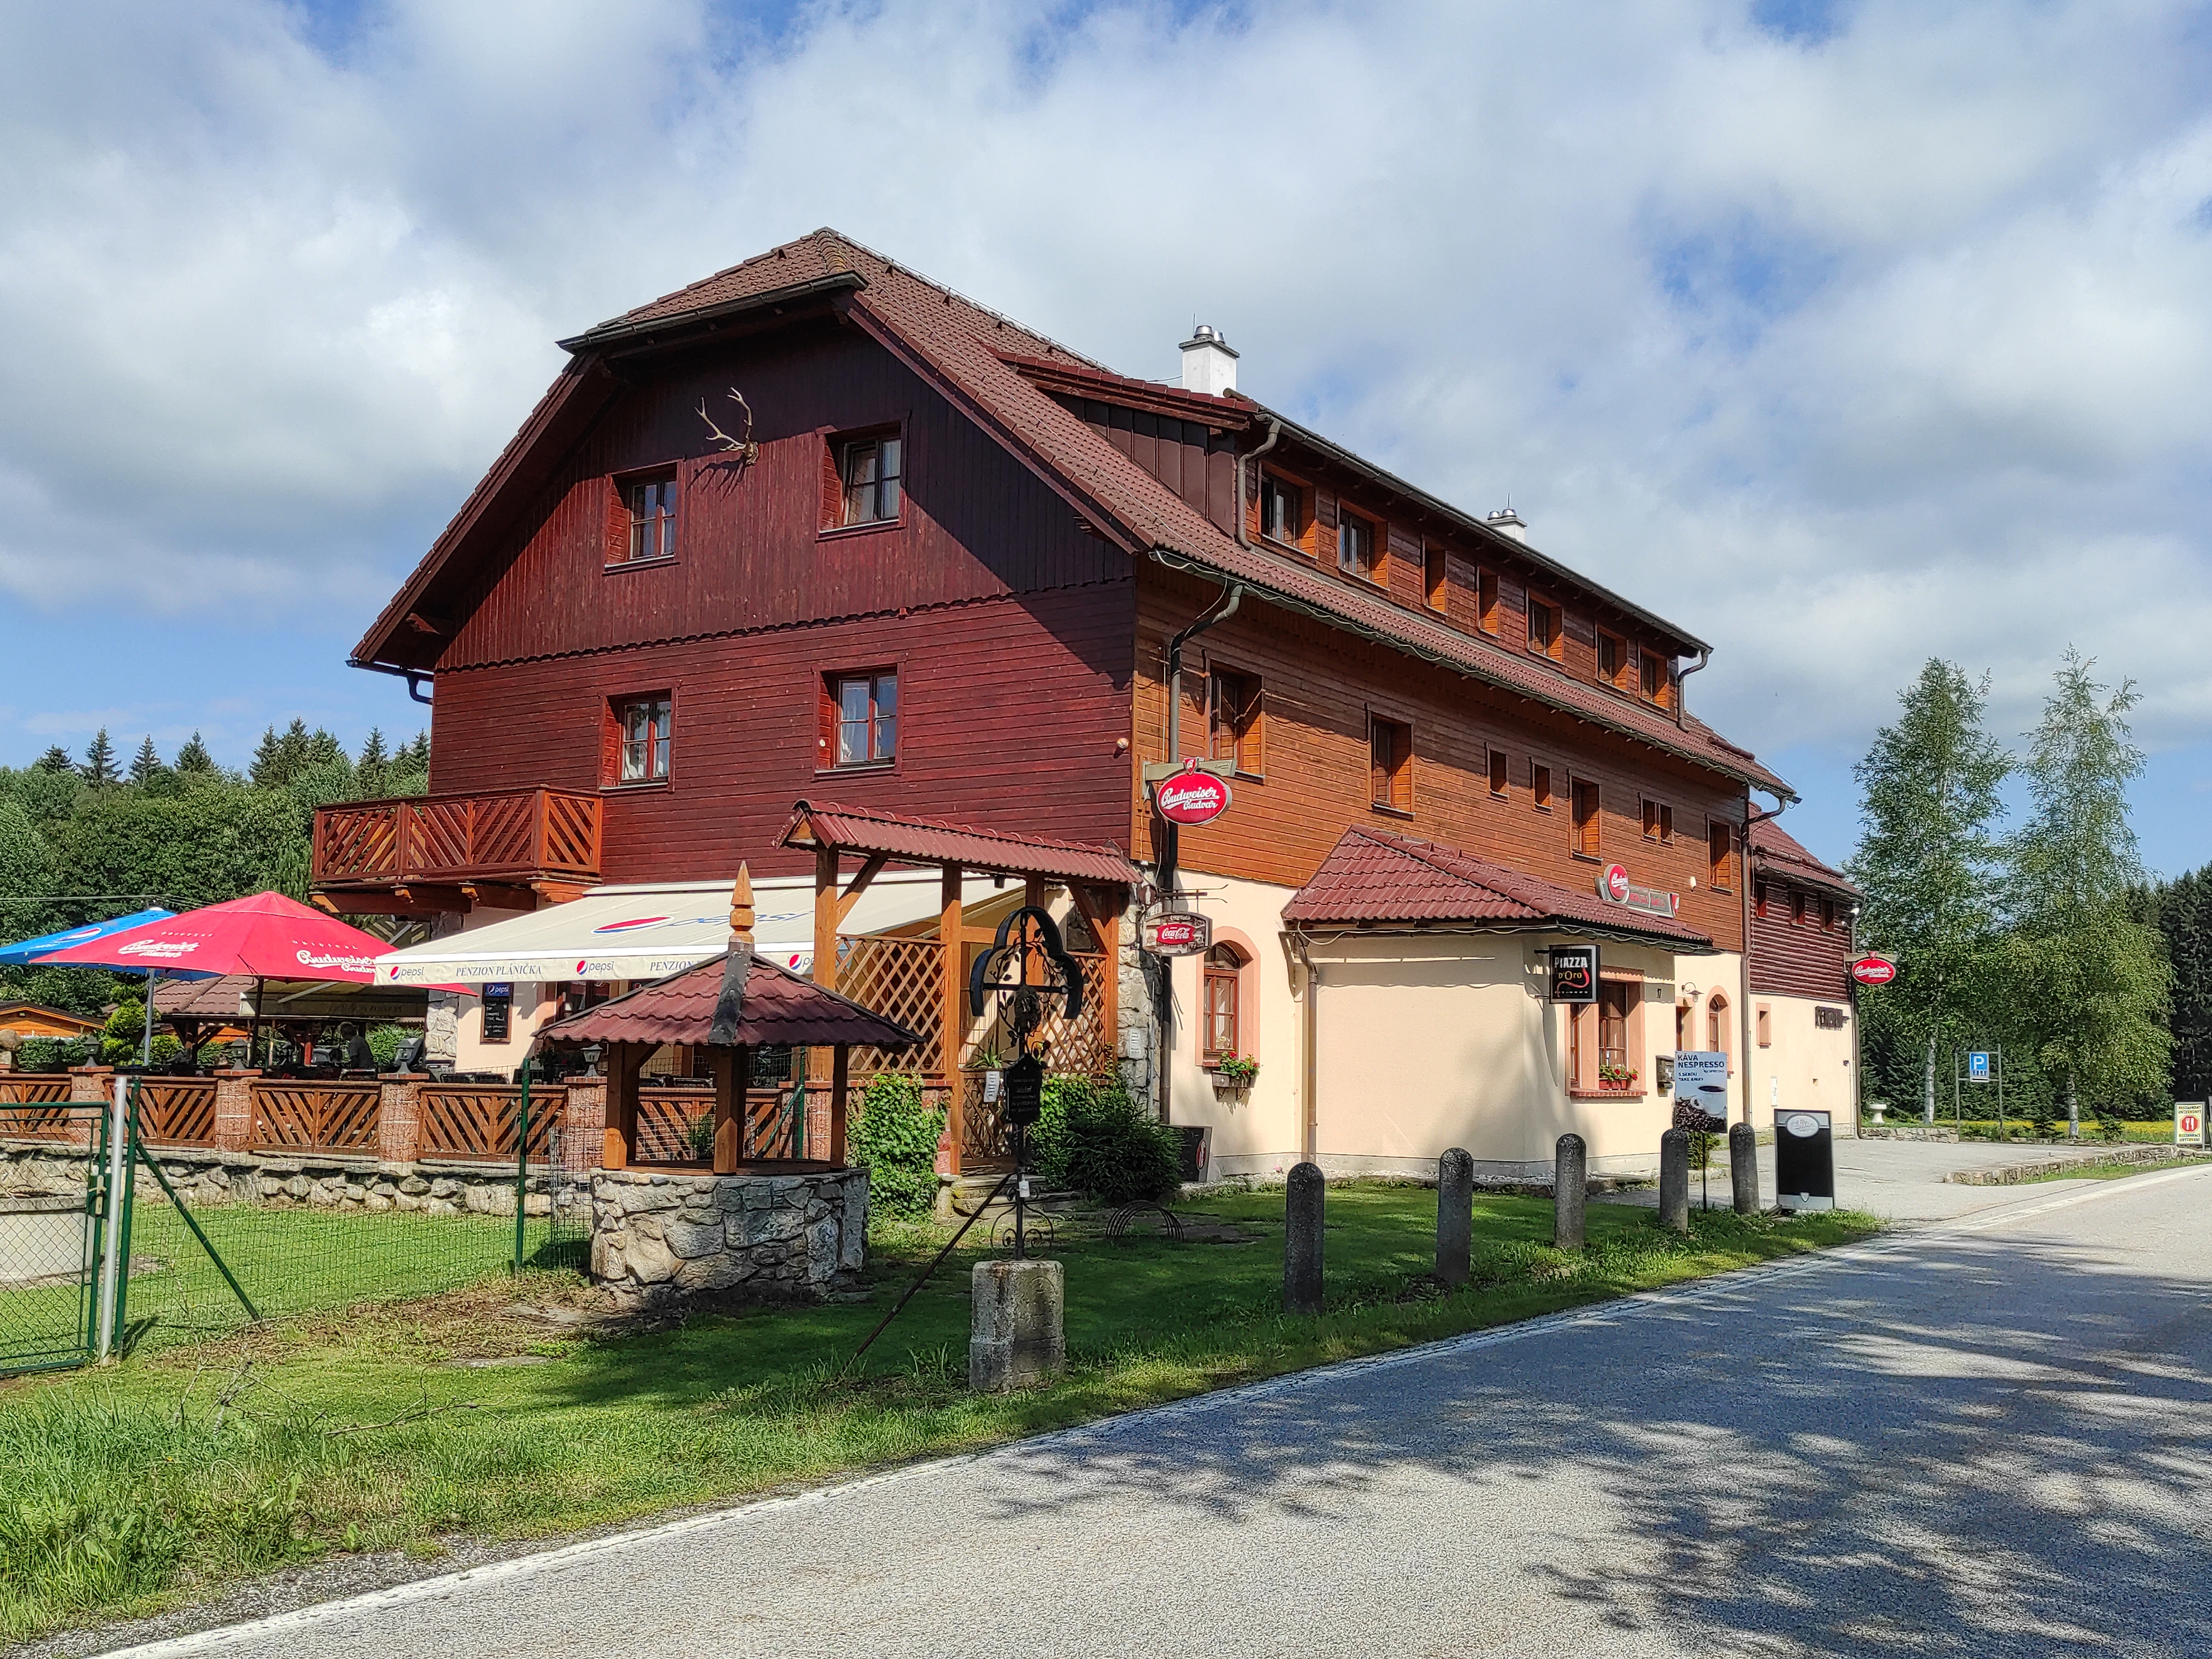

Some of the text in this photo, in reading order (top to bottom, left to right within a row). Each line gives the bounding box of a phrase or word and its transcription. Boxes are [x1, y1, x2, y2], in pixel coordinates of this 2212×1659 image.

[1161, 786, 1220, 810] Budweiser
[1183, 800, 1218, 811] Budvar
[1162, 926, 1191, 940] Coca-Cola
[588, 961, 614, 973] pepsi
[1554, 957, 1588, 968] PIAZZA
[400, 967, 424, 977] pepsi
[456, 967, 495, 977] PENZION
[1974, 1056, 1984, 1070] P
